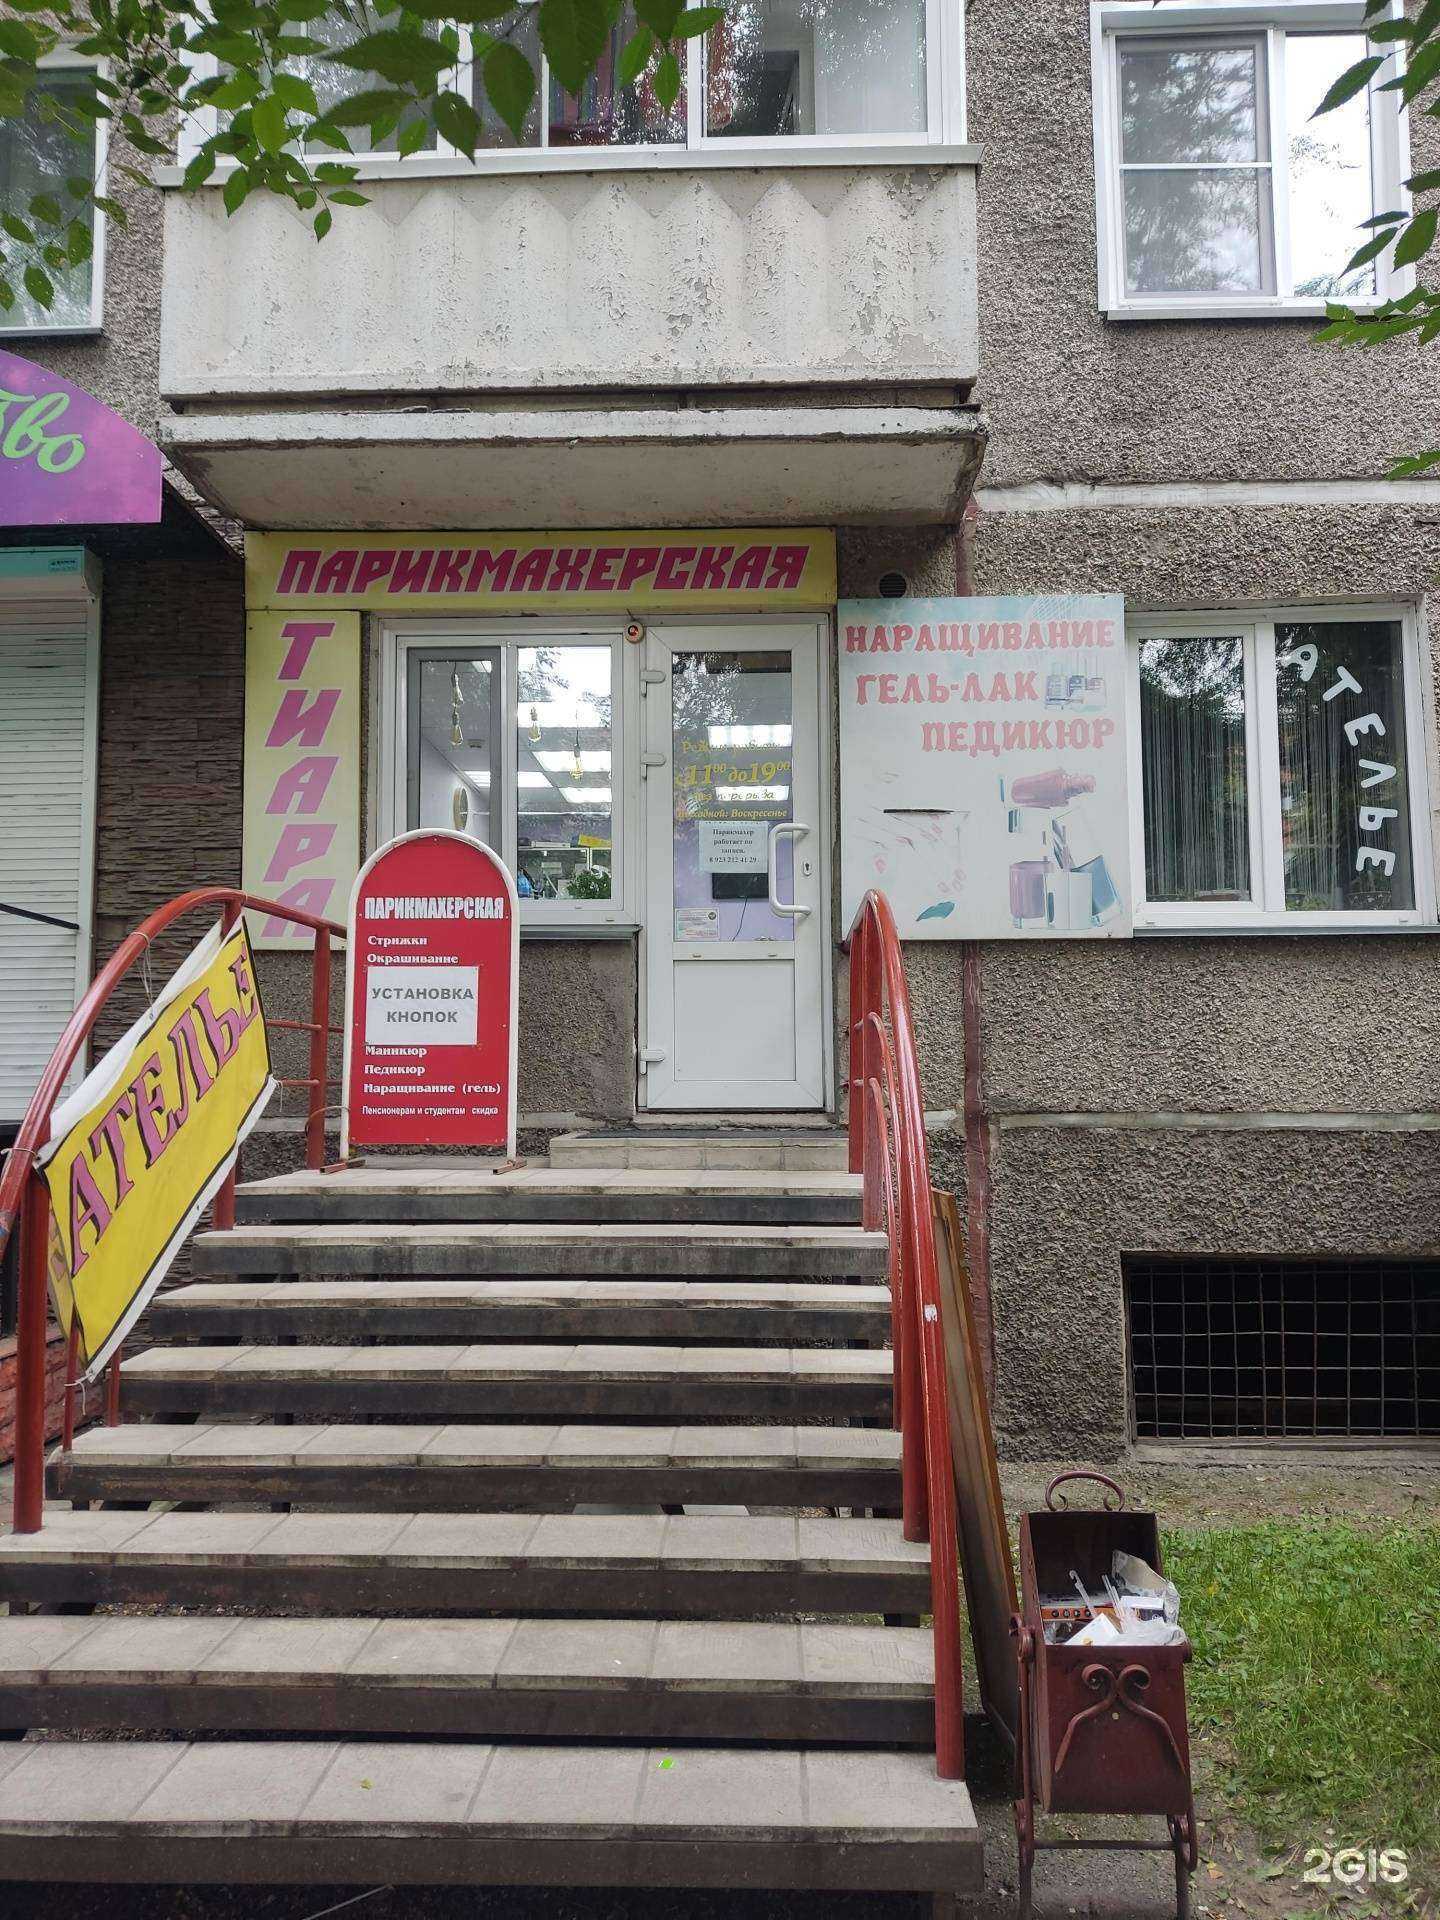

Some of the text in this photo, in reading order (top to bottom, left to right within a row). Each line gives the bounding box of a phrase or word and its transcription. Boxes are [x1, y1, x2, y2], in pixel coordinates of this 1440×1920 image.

[276, 546, 809, 594] ПАРИКМАХЕРСКАЯ
[845, 619, 1115, 657] НАРАЩИВАНИЕ
[856, 671, 1039, 705] ГЕЛЬ-ЛАК
[921, 717, 1114, 757] ПЕДИКЮР
[1287, 643, 1398, 876] АТЕЛЬЕ
[261, 622, 342, 938] ТИАРА
[731, 808, 787, 819] Воскресенье
[364, 897, 504, 919] ПАРИКМАХЕРСКАЯ
[367, 936, 428, 947] Стрижки
[366, 954, 459, 964] Окрашивание
[371, 987, 475, 1000] УСТАНОВКА
[386, 1011, 458, 1023] КНОПОК
[365, 1046, 427, 1057] Маникюр
[364, 1065, 426, 1076] Педикюр
[363, 1083, 502, 1095] Наращивание (гель)
[71, 941, 259, 1278] АТЕЛЬЕ
[362, 1105, 499, 1117] Пенсионерам и студентам скидка
